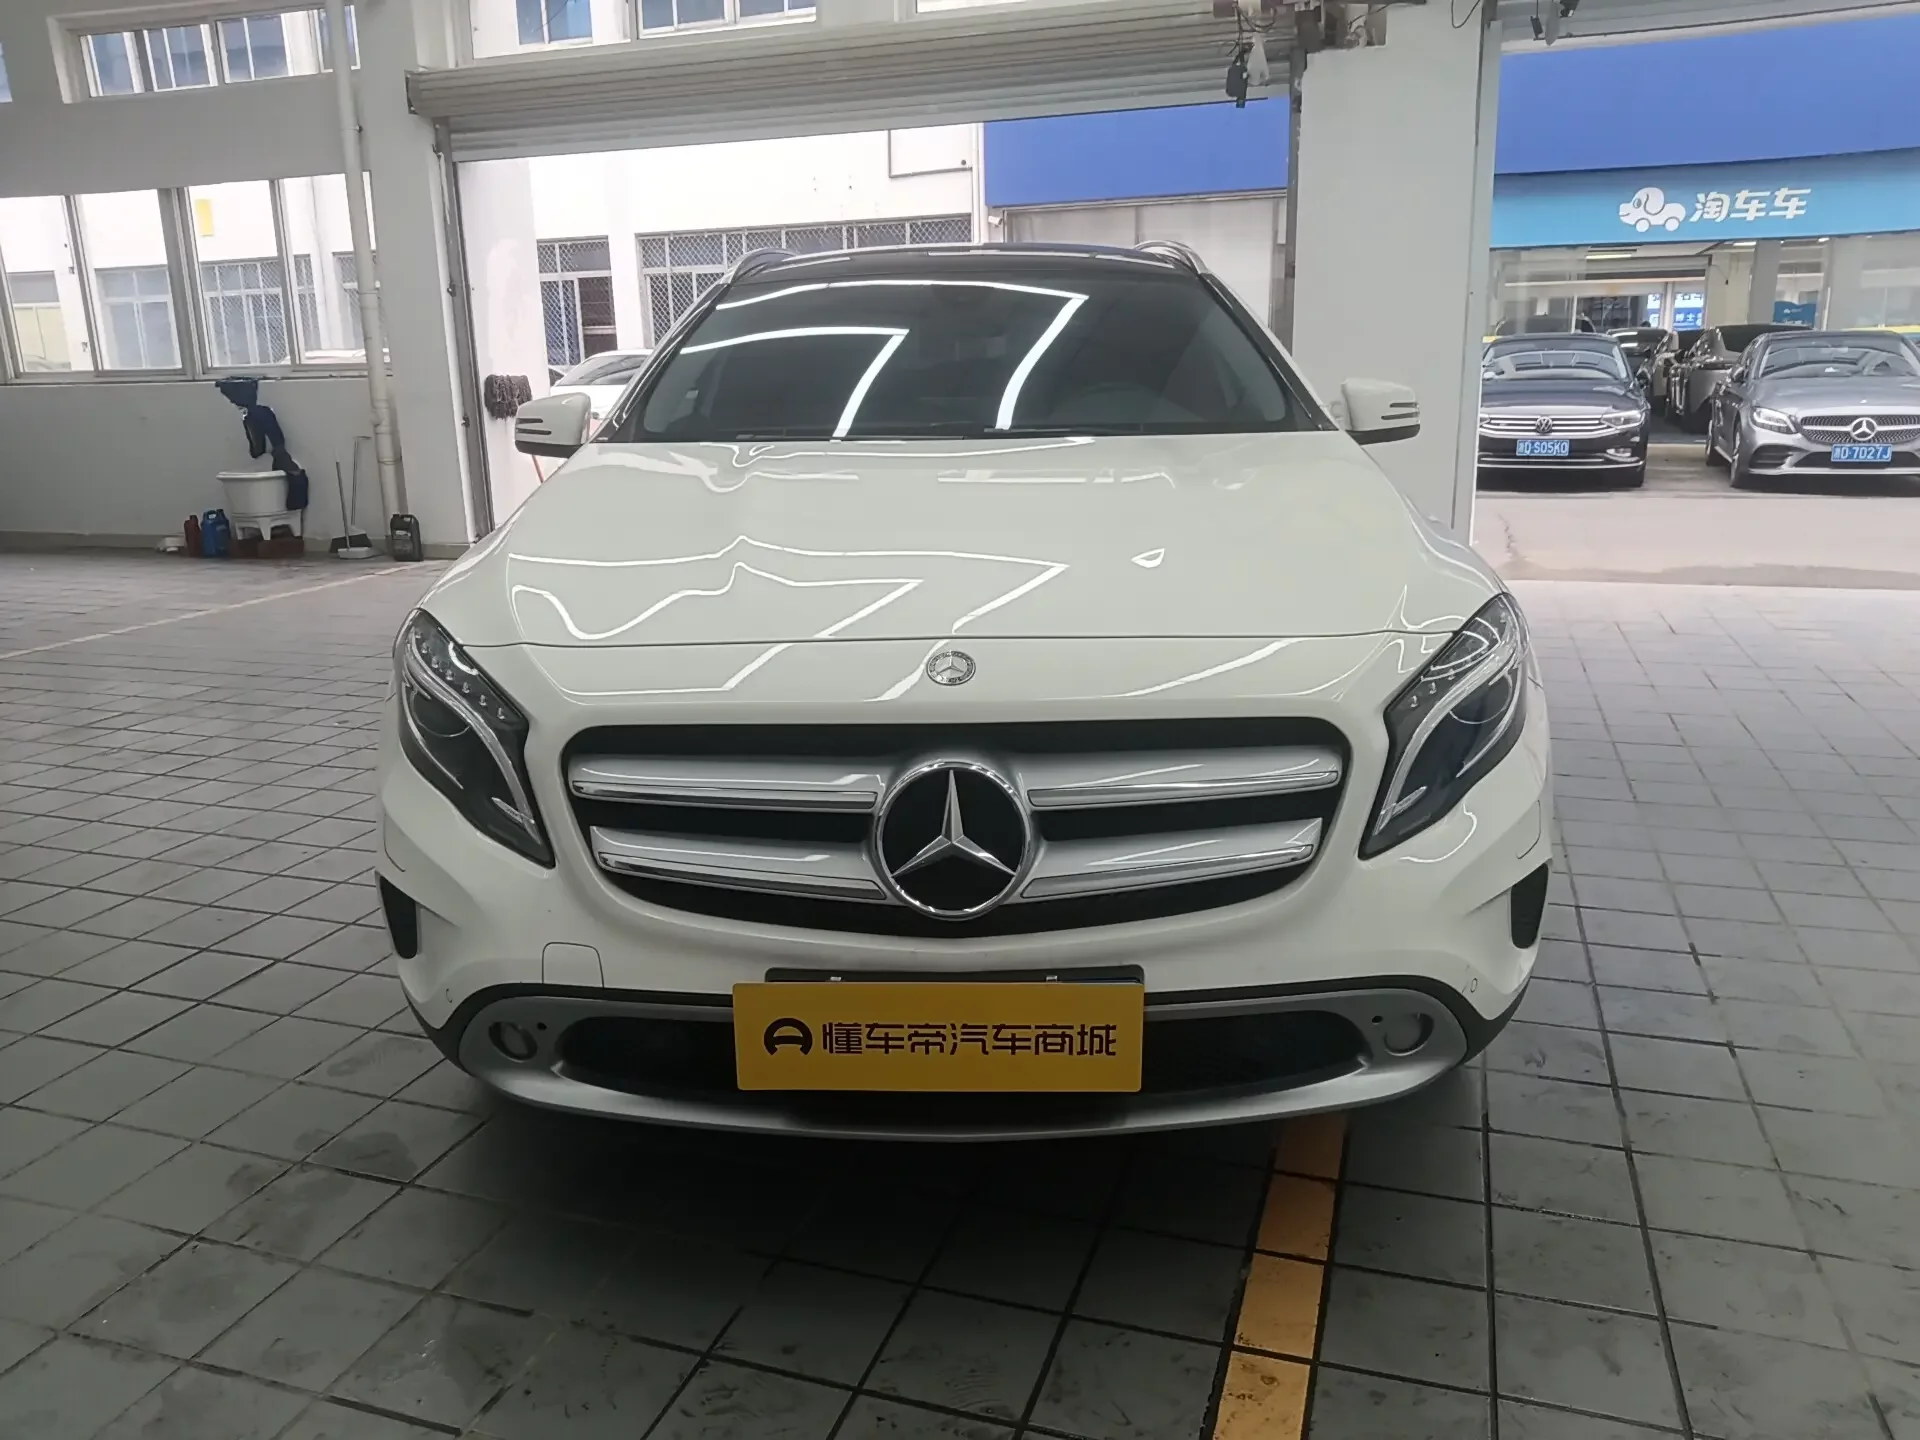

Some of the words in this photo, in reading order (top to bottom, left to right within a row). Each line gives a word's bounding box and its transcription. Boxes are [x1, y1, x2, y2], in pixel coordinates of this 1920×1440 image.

[1689, 187, 1811, 222] 淘车车
[822, 1022, 1117, 1056] 懂车帝汽车商城
